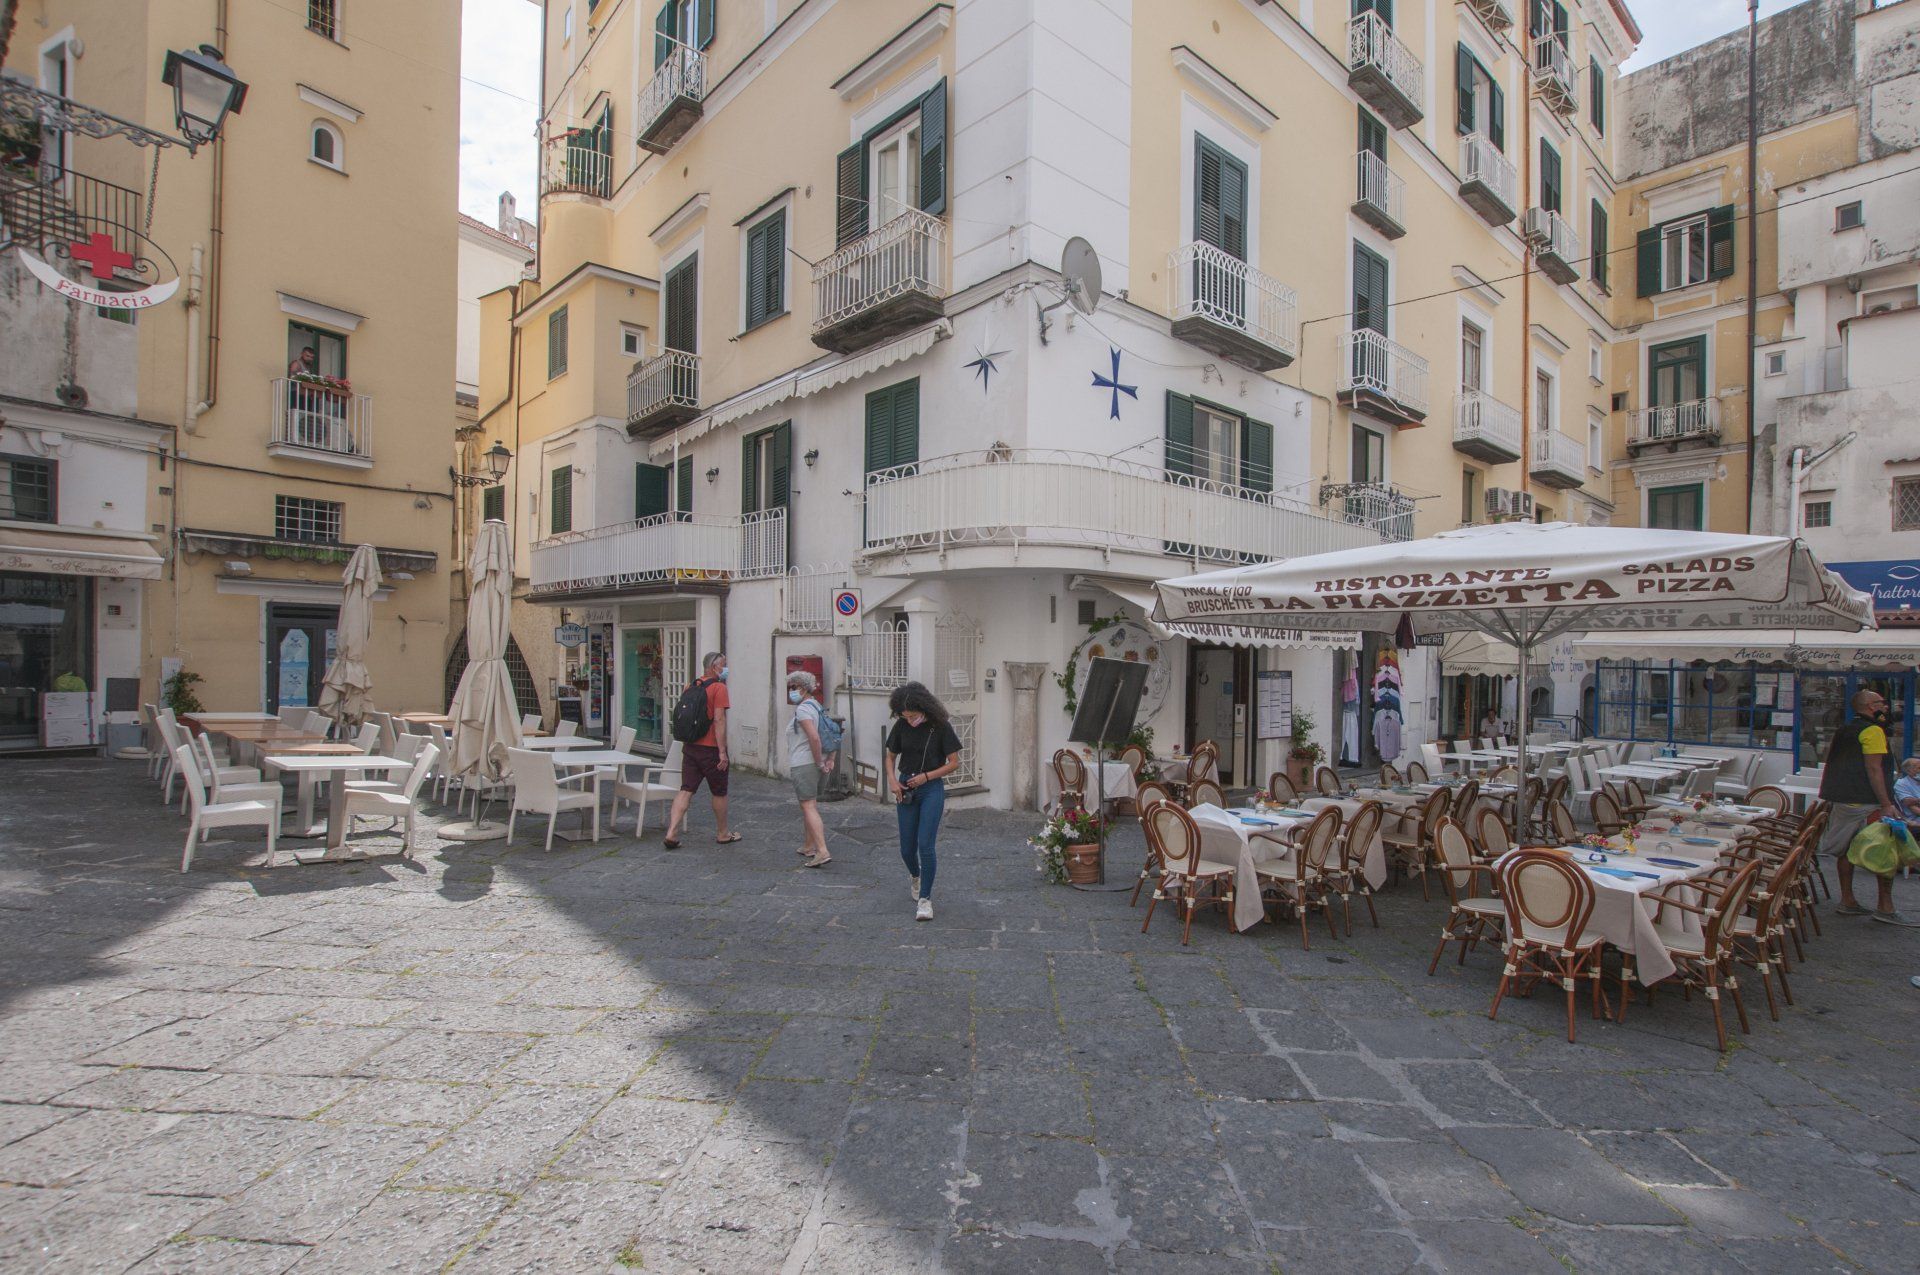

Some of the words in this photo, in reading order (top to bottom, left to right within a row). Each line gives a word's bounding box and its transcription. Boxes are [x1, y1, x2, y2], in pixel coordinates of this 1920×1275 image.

[56, 279, 152, 308] Farmacia
[1622, 556, 1755, 575] SALADS
[1314, 568, 1551, 592] RISTORANTE
[1637, 577, 1735, 593] PIZZA
[1258, 597, 1315, 610] LA
[1321, 579, 1620, 609] PIAZZETTA
[1187, 599, 1255, 613] BRUSCHETTE
[1164, 621, 1233, 637] RISTORANTE
[1416, 636, 1443, 645] LIBERO
[1735, 648, 1772, 660] Antica
[1853, 648, 1914, 660] Barracca
